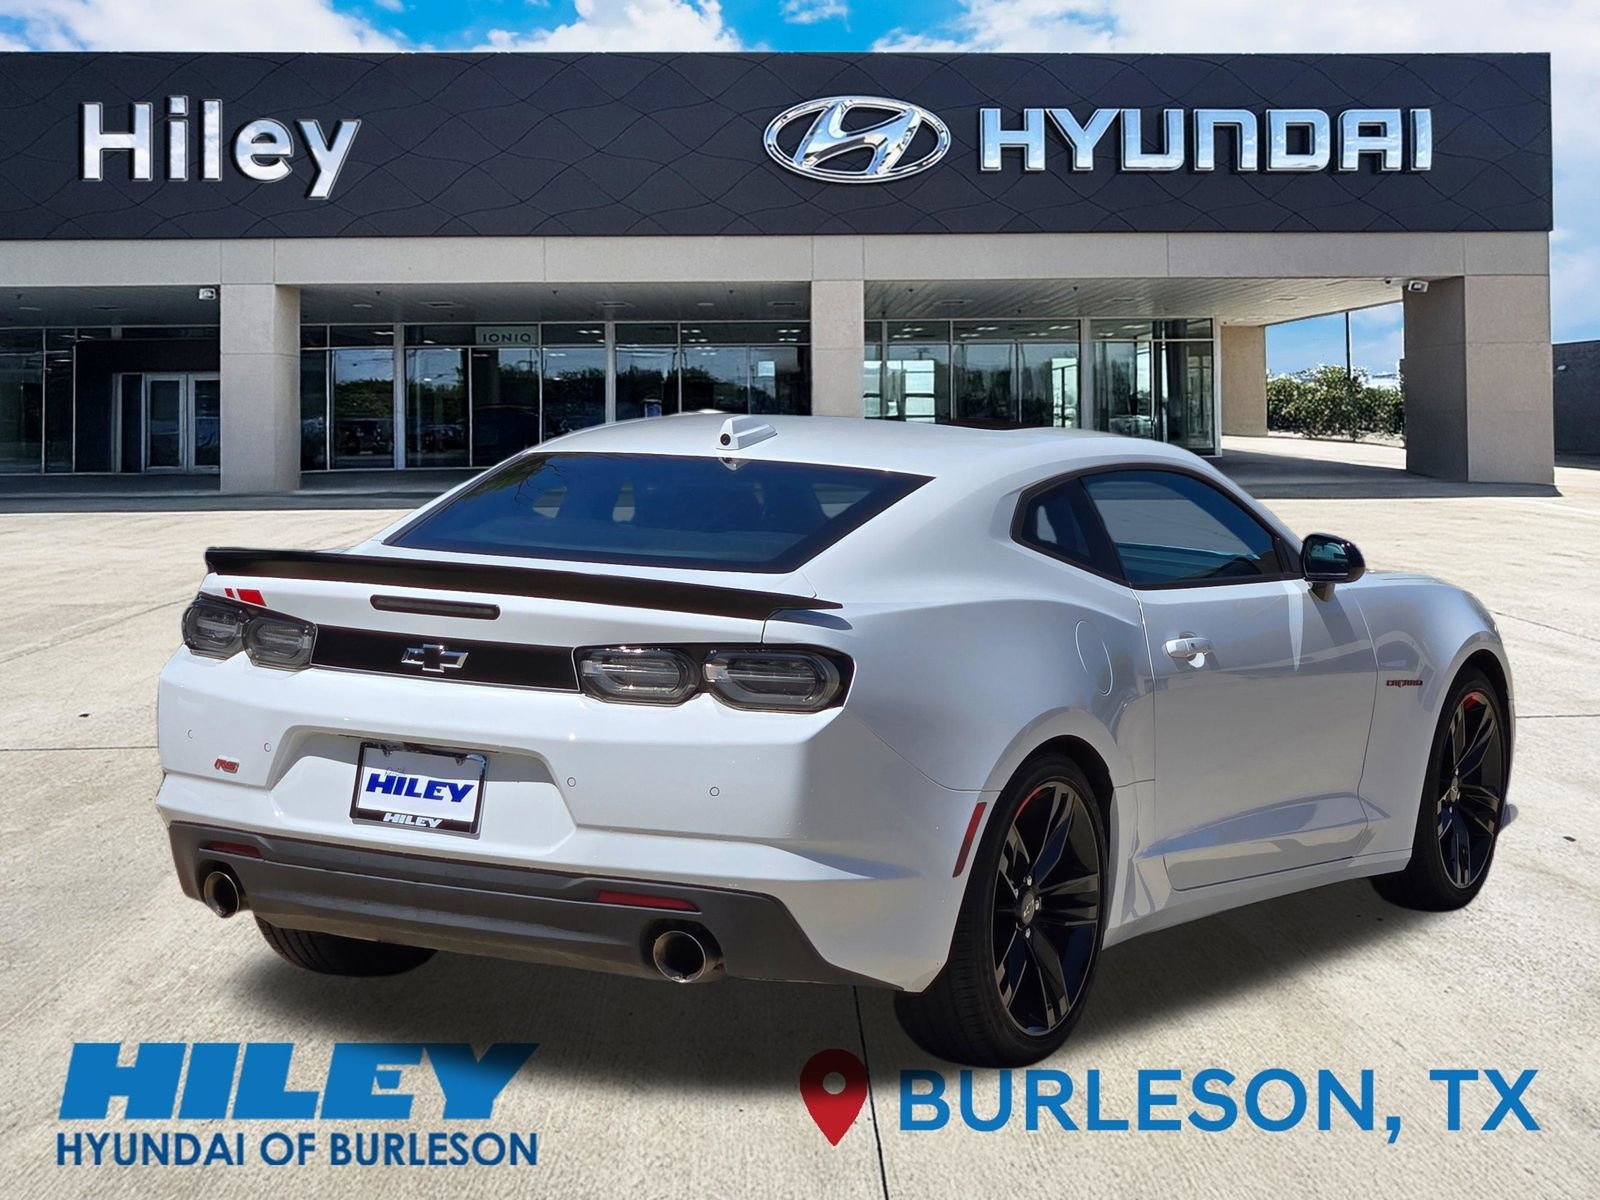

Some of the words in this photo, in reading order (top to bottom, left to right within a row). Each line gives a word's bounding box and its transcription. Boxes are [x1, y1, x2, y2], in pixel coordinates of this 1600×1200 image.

[80, 95, 362, 200] Hiley
[979, 107, 1434, 173] HYUNDAI
[365, 773, 475, 803] HILEY
[382, 812, 443, 828] HILEY
